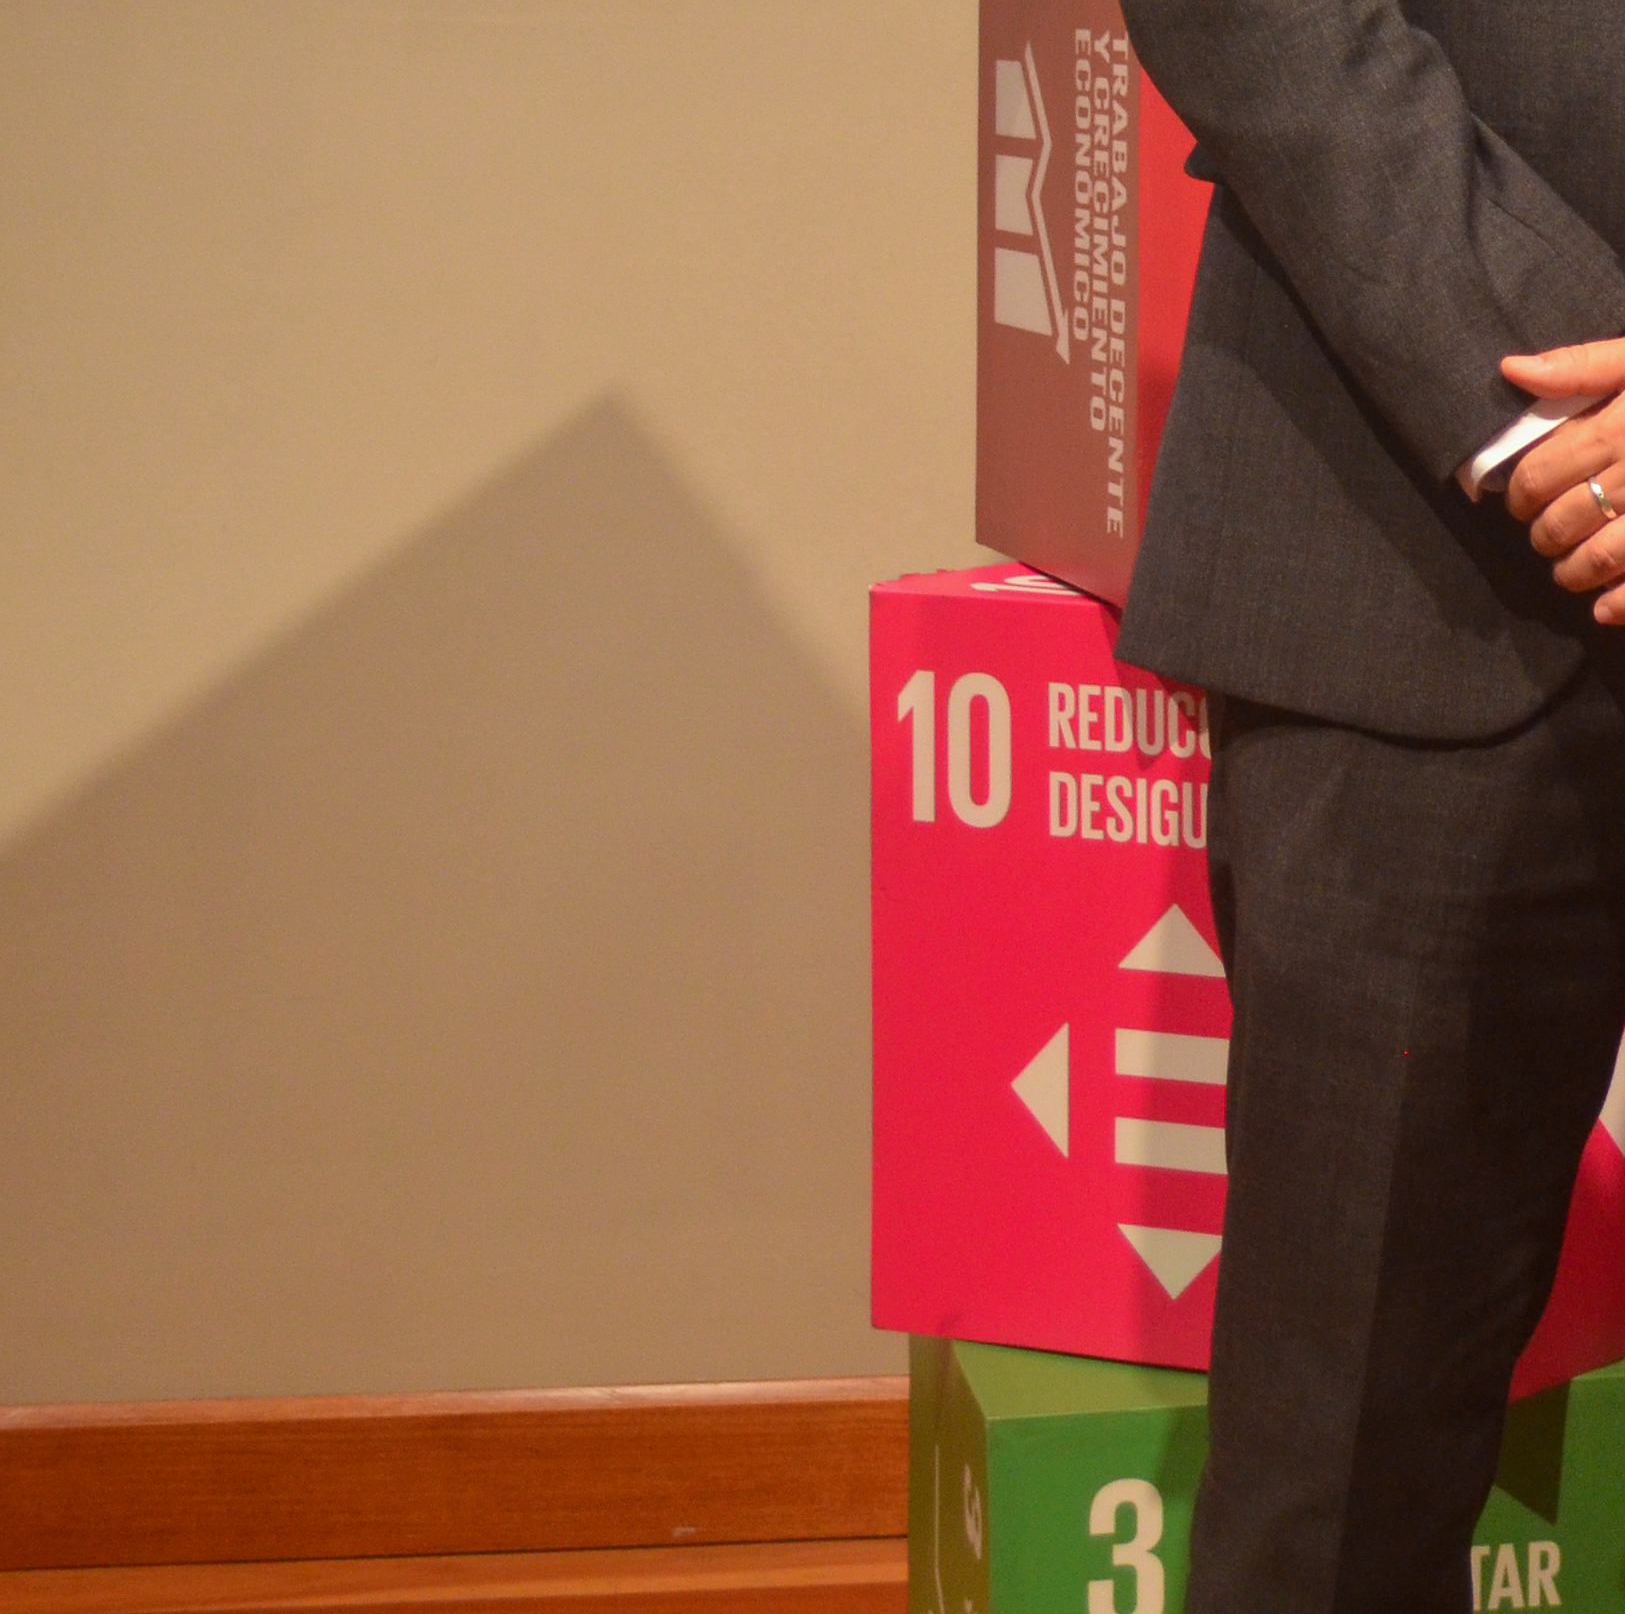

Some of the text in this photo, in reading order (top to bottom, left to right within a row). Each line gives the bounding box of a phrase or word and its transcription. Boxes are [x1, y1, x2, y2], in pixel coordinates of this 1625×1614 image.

[1090, 30, 1110, 432] Y CRECIMIENTO
[1106, 29, 1129, 538] TRABAJO DECENTE
[897, 669, 1012, 828] 10
[1049, 771, 1209, 849] DESIGU
[1088, 1478, 1165, 1614] 3
